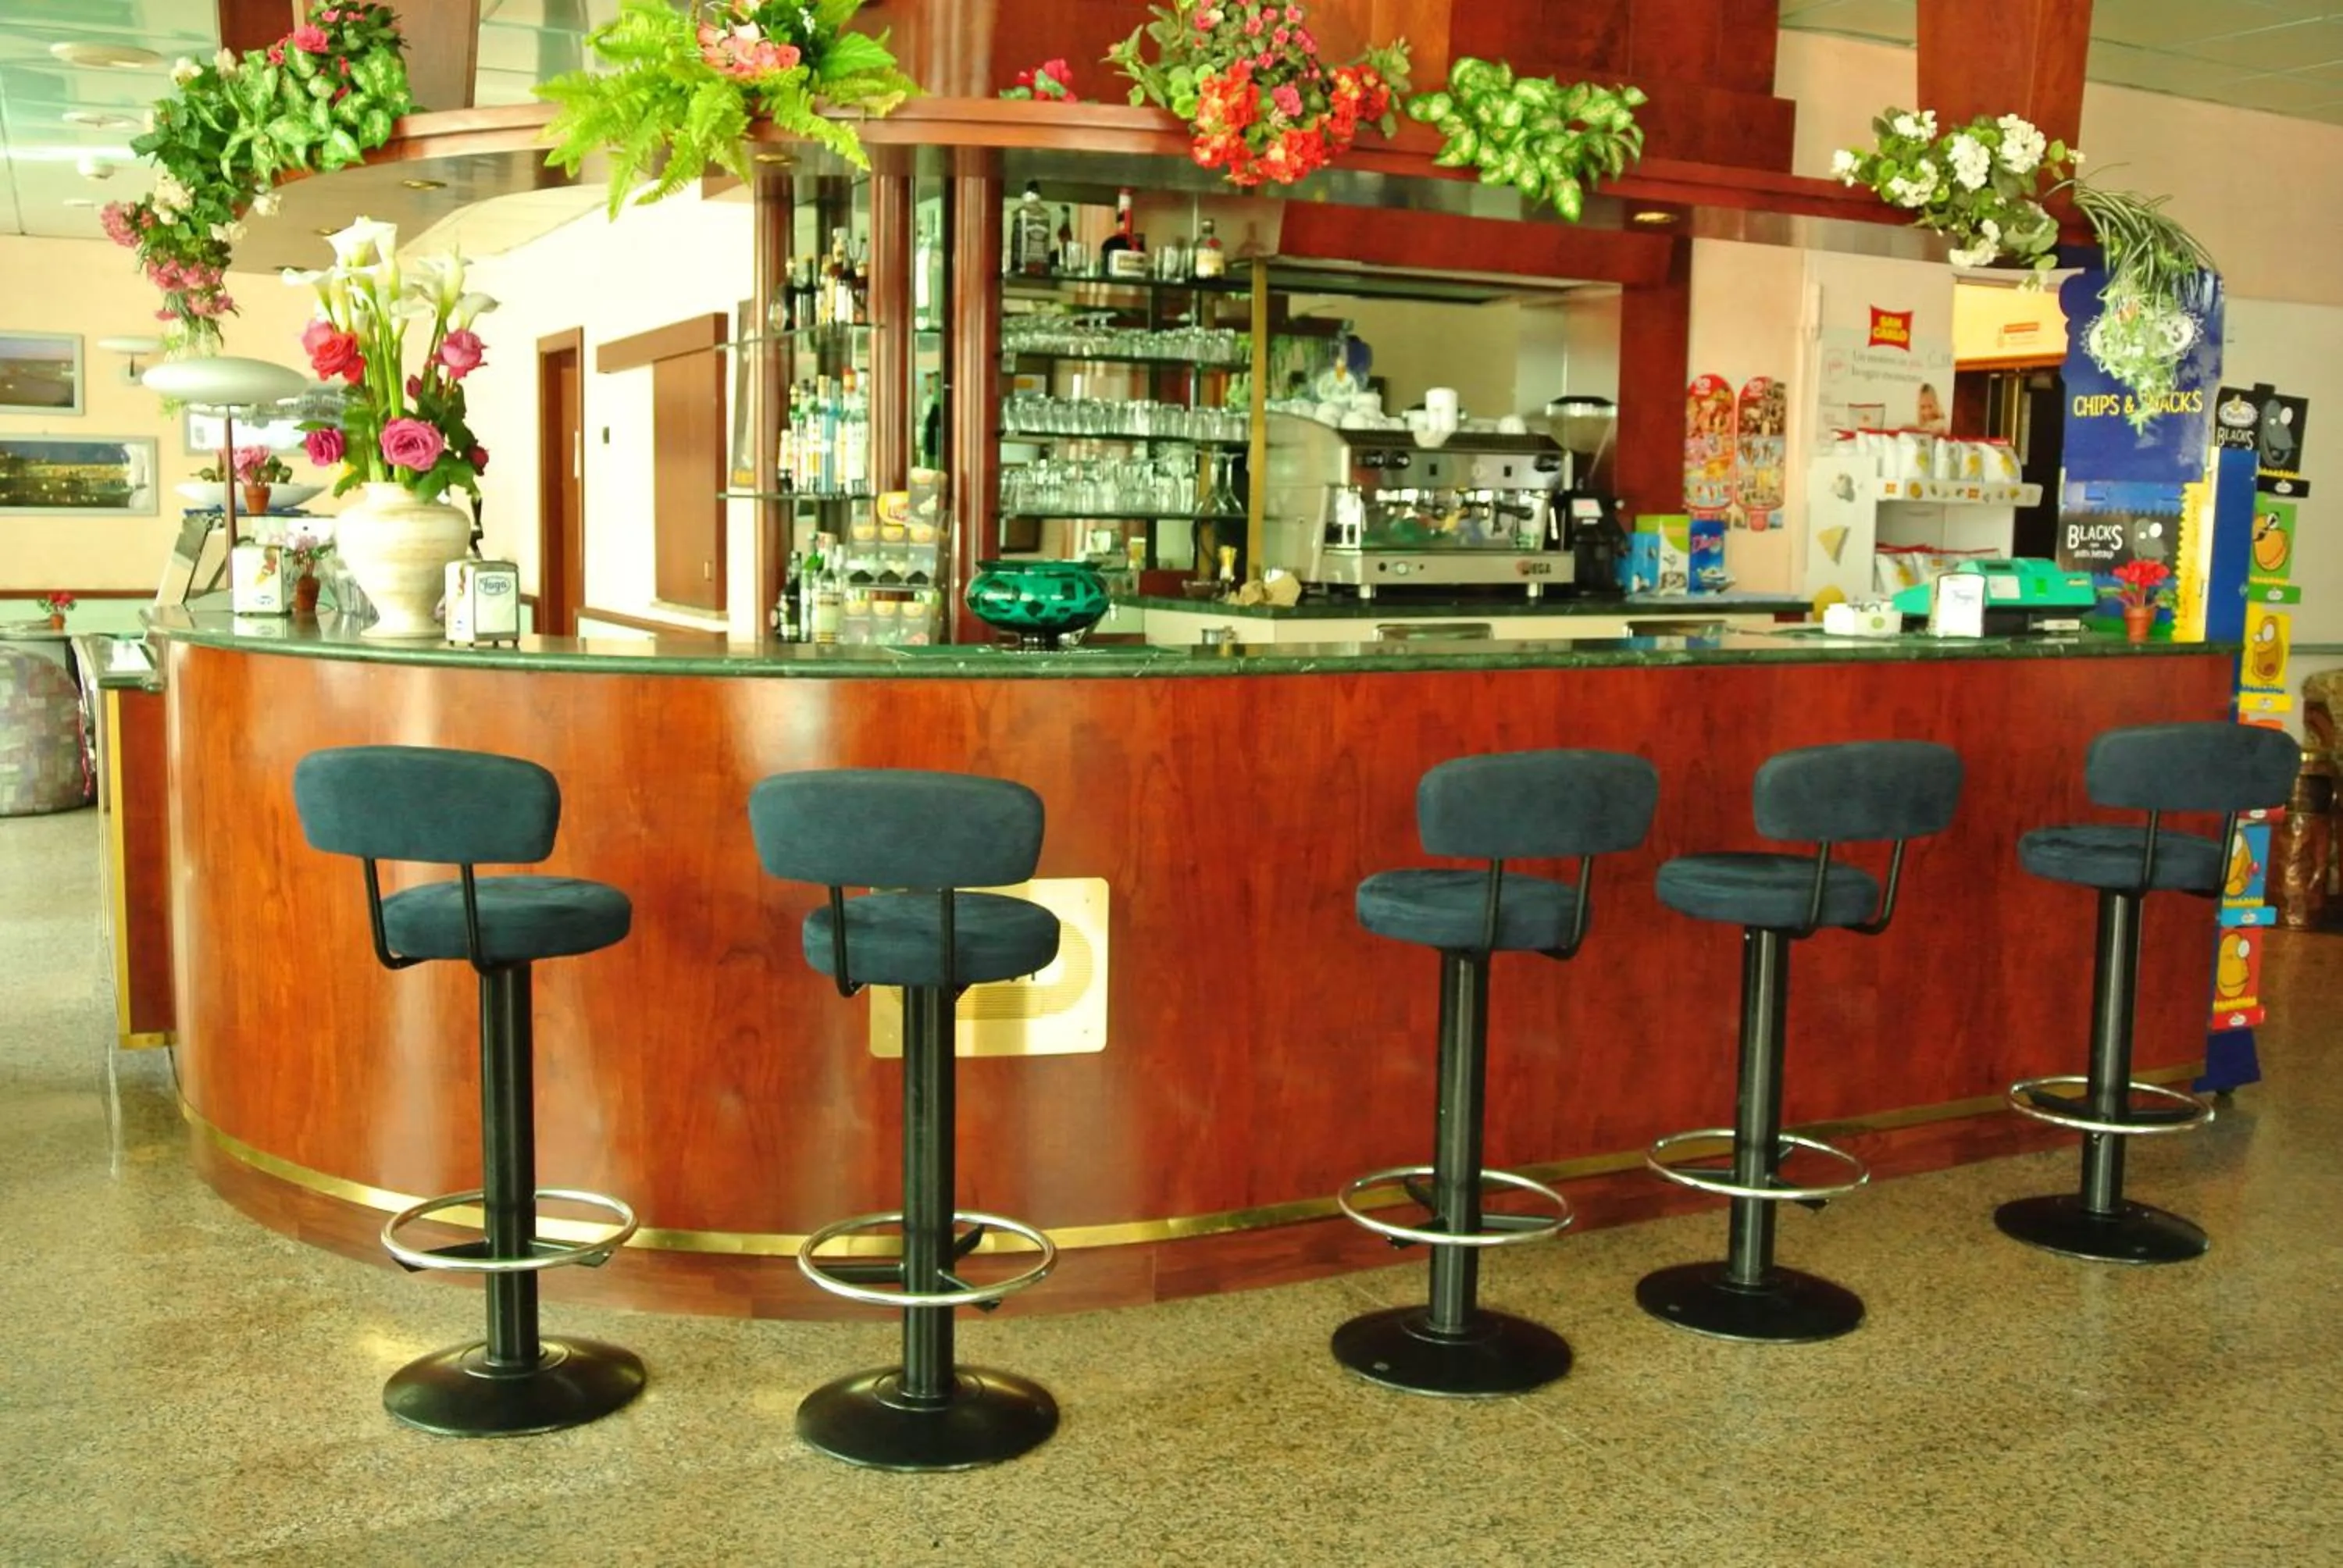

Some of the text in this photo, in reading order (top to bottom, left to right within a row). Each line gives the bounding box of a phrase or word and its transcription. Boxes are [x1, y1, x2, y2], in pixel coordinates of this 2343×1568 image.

[1879, 315, 1903, 328] SAN
[1873, 326, 1908, 342] CARLO
[2074, 394, 2120, 418] CHIPS
[2124, 394, 2134, 415] &
[2067, 524, 2124, 551] BLACKS
